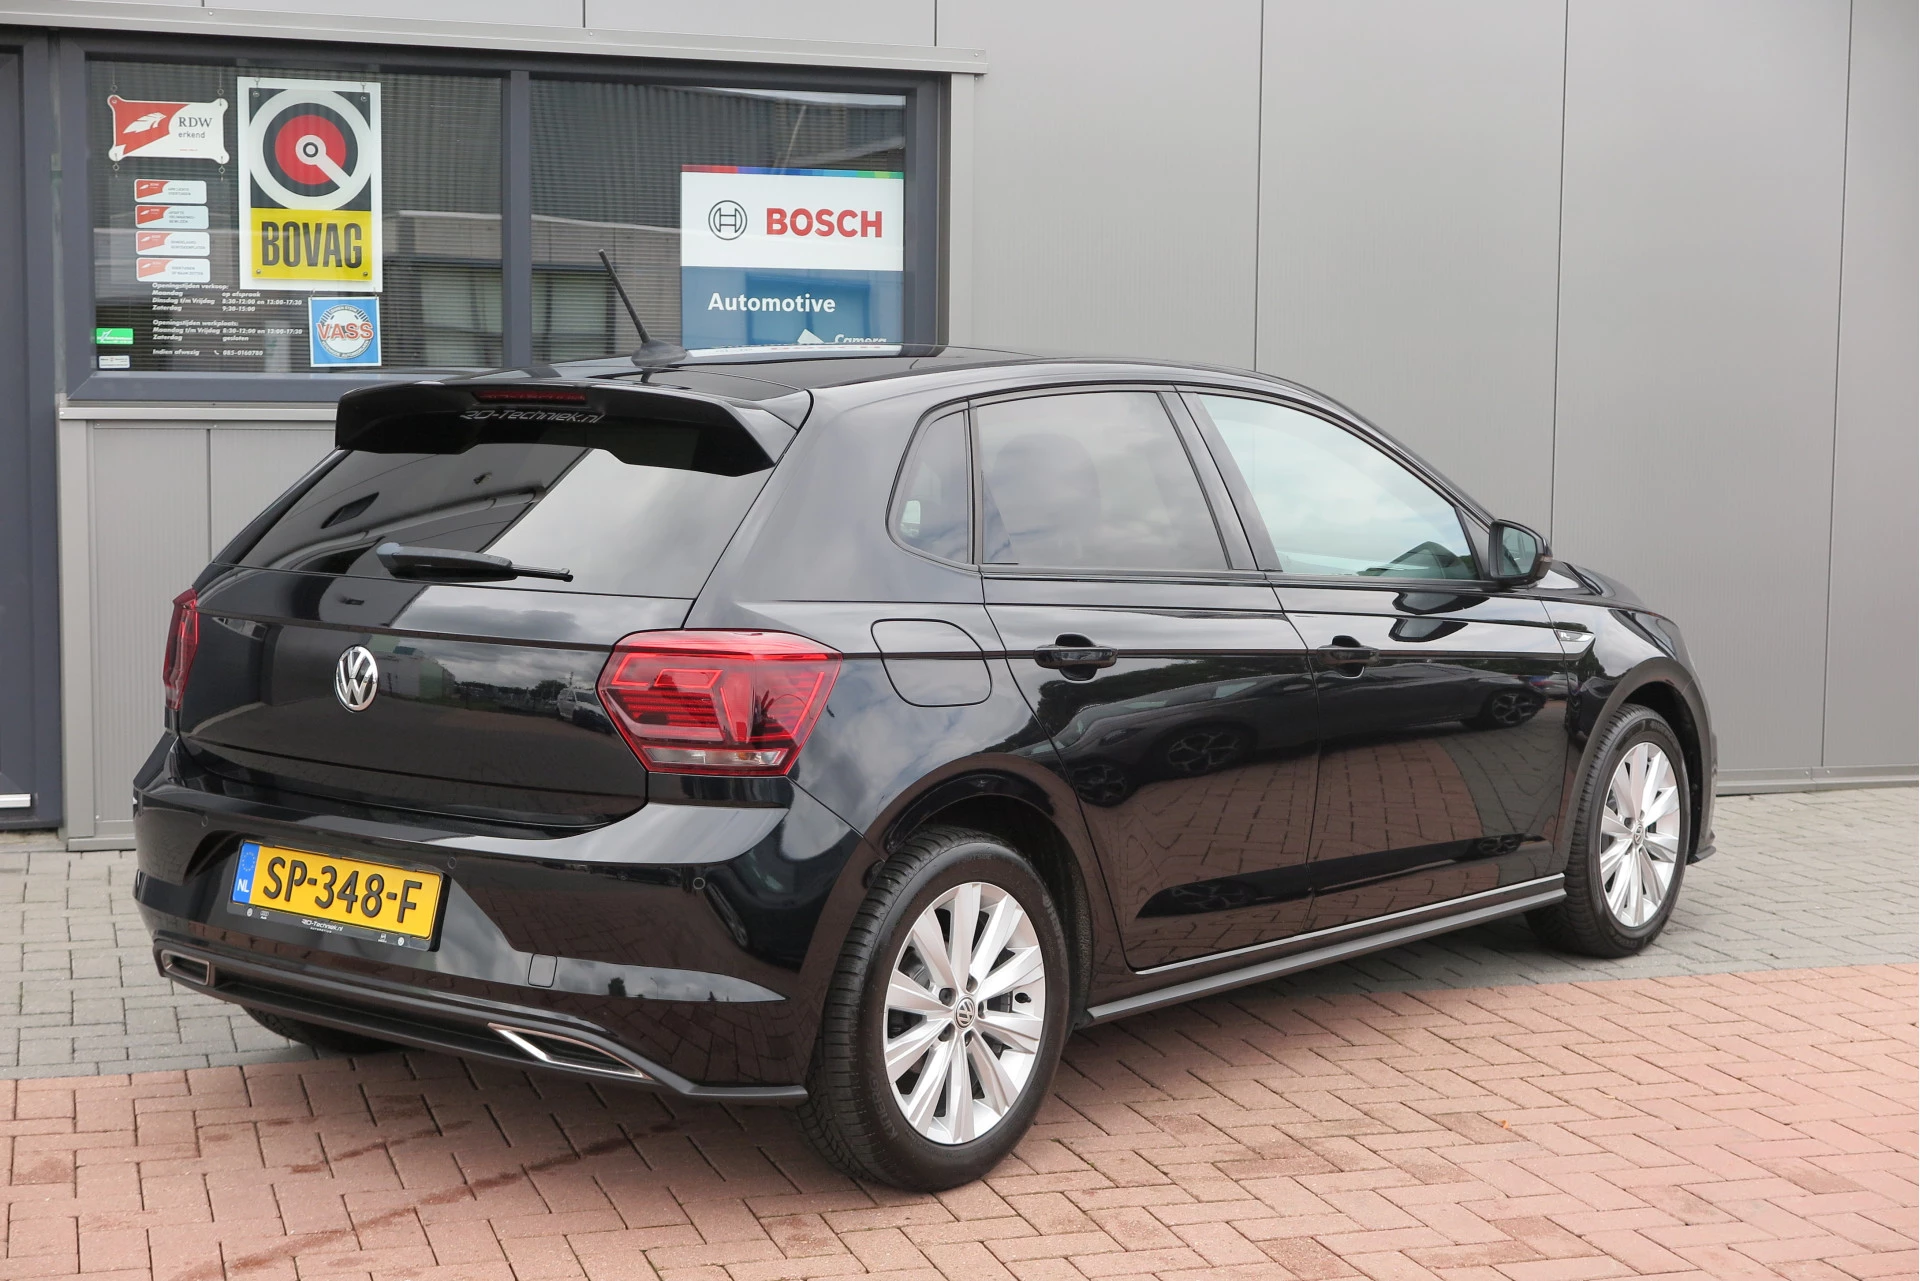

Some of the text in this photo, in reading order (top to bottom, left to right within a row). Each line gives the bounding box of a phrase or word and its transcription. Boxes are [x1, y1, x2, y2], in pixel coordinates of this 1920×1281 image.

[178, 116, 213, 128] RDW
[178, 131, 206, 139] erkend
[766, 207, 883, 238] BOSCH
[260, 220, 363, 268] BOVAG
[152, 282, 200, 290] Openingstijden
[192, 297, 216, 305] Vrijdag
[707, 292, 836, 313] Automotive
[152, 319, 200, 327] Openingstijden
[197, 327, 221, 335] Vrijdag
[316, 322, 375, 340] VASS
[174, 348, 200, 356] afwezig
[237, 878, 249, 892] NL
[262, 856, 422, 924] SP-348-F
